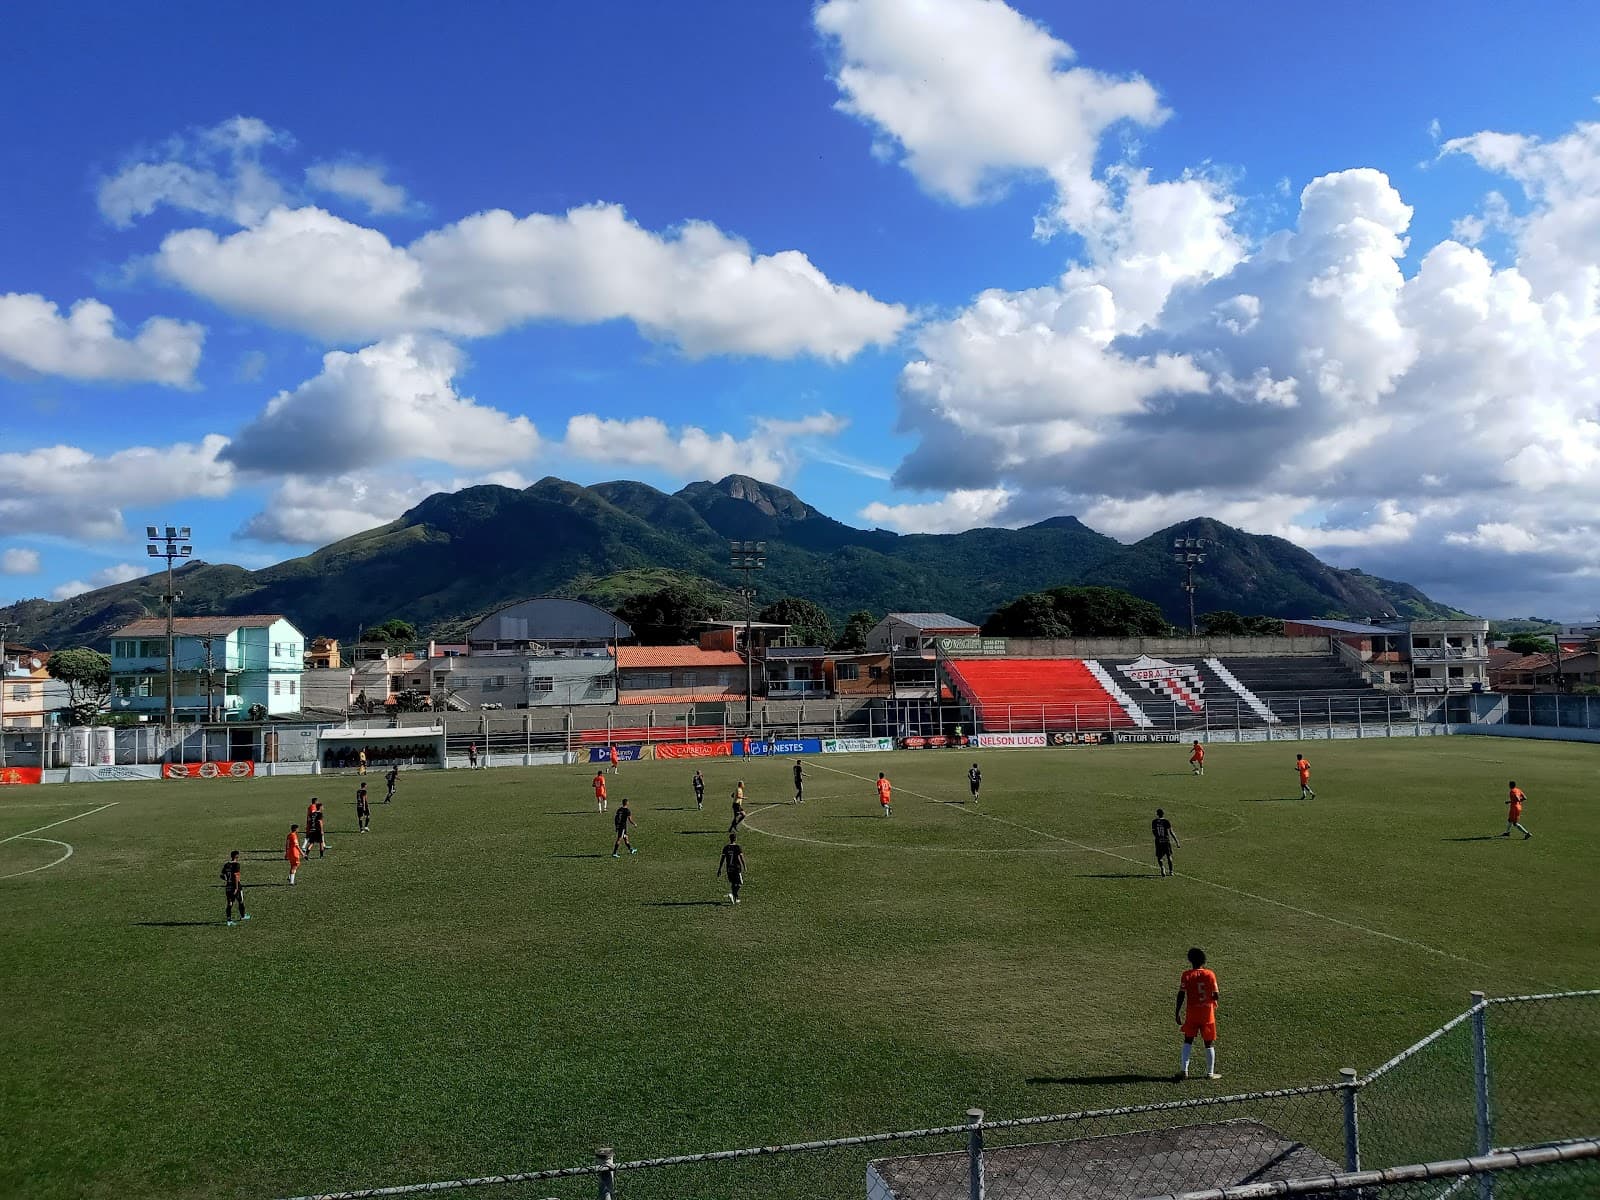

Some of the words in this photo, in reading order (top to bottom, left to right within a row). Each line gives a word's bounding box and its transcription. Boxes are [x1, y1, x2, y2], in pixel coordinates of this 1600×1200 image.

[980, 736, 1015, 745] NELSON
[1017, 736, 1045, 745] LUCAS
[1084, 733, 1102, 743] BET
[1118, 734, 1148, 742] VETTOR
[1150, 734, 1180, 742] VETTOR
[676, 745, 712, 754] CARRETÃO
[1197, 982, 1206, 1002] 5
